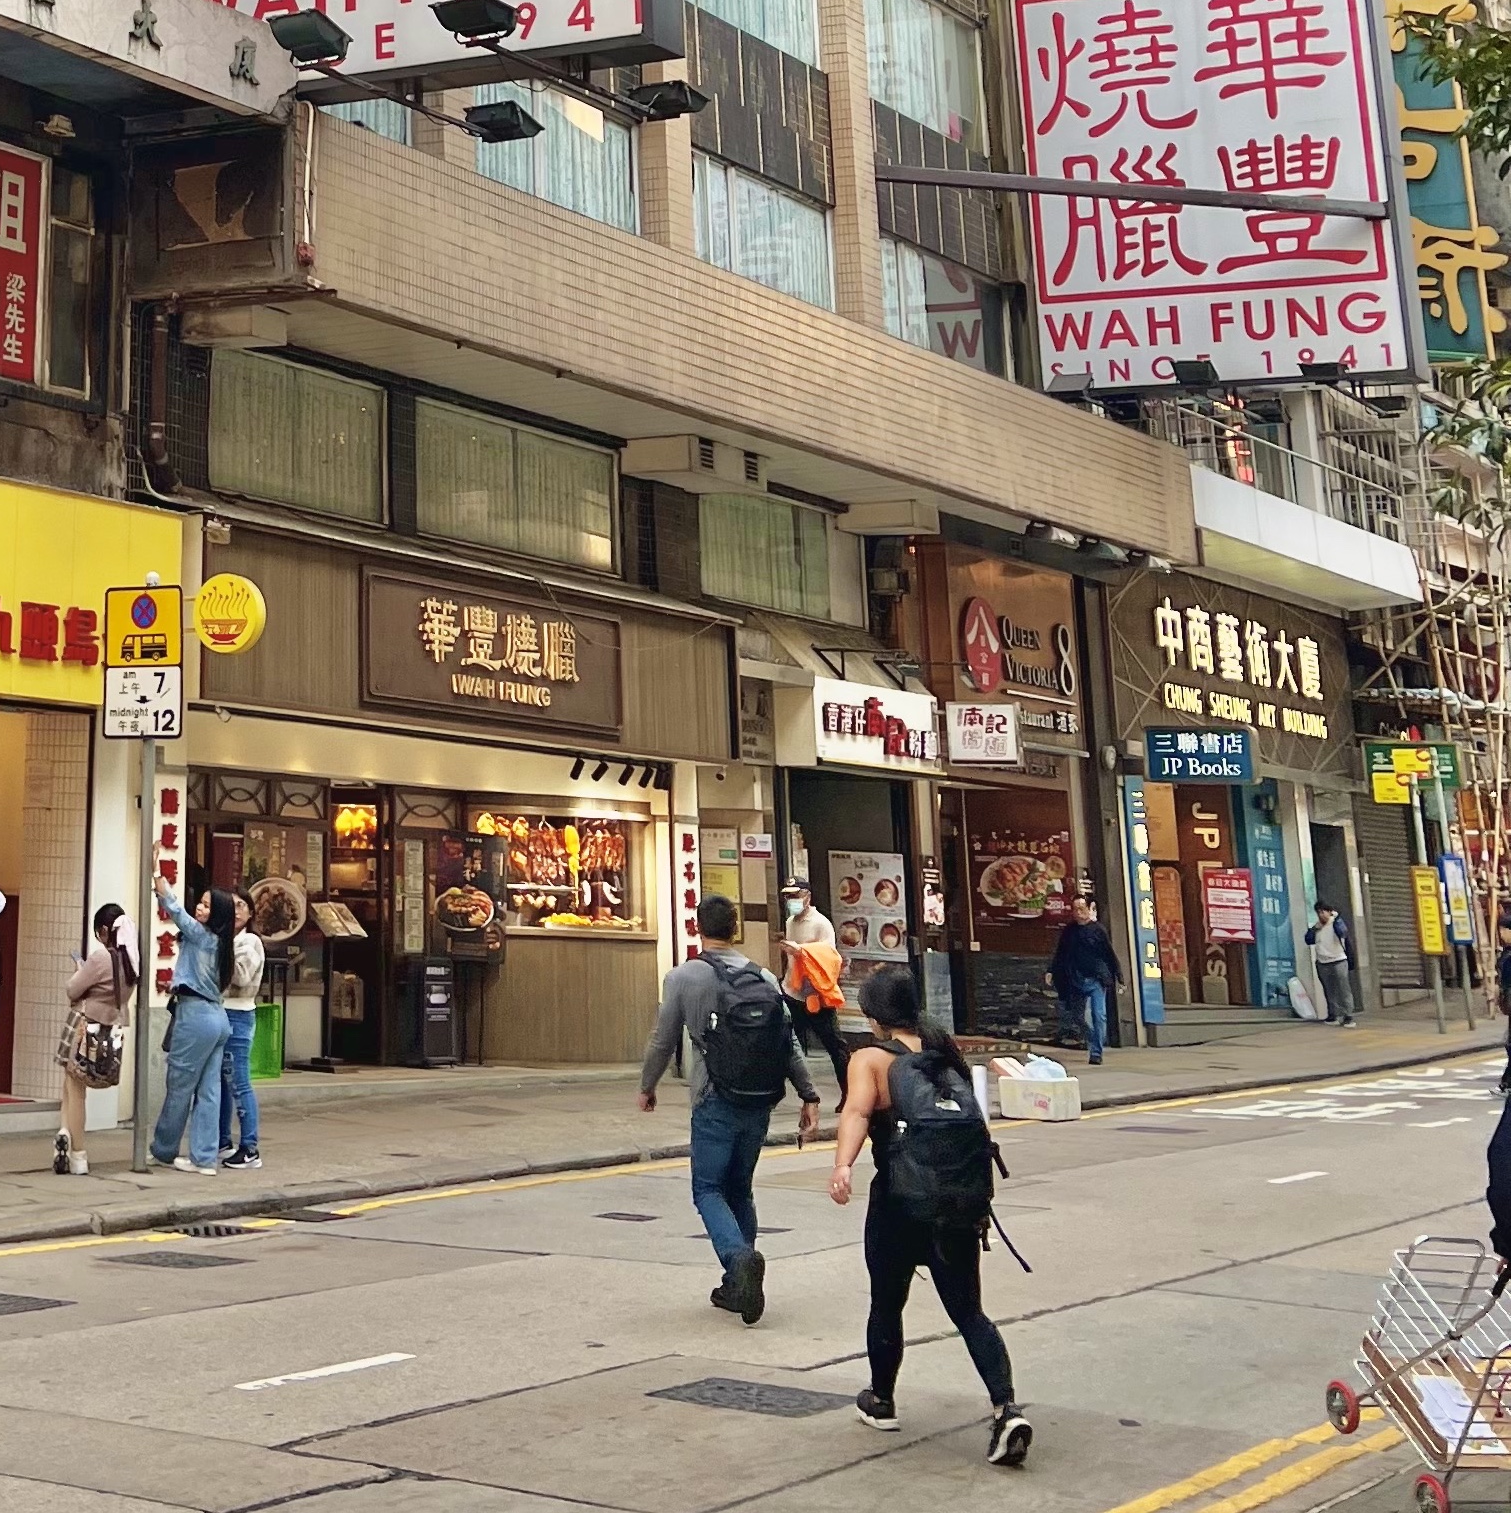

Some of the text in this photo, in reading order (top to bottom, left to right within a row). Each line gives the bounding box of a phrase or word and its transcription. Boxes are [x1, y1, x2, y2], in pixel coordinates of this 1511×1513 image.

[1037, 0, 1209, 287] 燒臘
[2, 272, 27, 364] 梁先生
[1044, 291, 1387, 353] WAH FUNG
[1051, 351, 1210, 382] SINC
[418, 597, 580, 683] 華豐燒臘
[1002, 616, 1041, 650] QUEEN
[1153, 597, 1324, 701] 中商藝術大廈
[123, 671, 136, 679] am
[1005, 624, 1075, 696] VICTORIA 8
[119, 672, 166, 695] 上午 7
[452, 673, 551, 707] WAH FUNG
[109, 707, 149, 718] midnight
[118, 709, 175, 733] 午夜 12
[964, 707, 1008, 734] 南記
[1020, 709, 1054, 729] staurant
[1164, 683, 1328, 740] CHUNG SHEUNG ART BUILDING
[1155, 733, 1243, 755] 三聯書店
[1162, 757, 1243, 777] JP Books
[1192, 802, 1220, 849] JP
